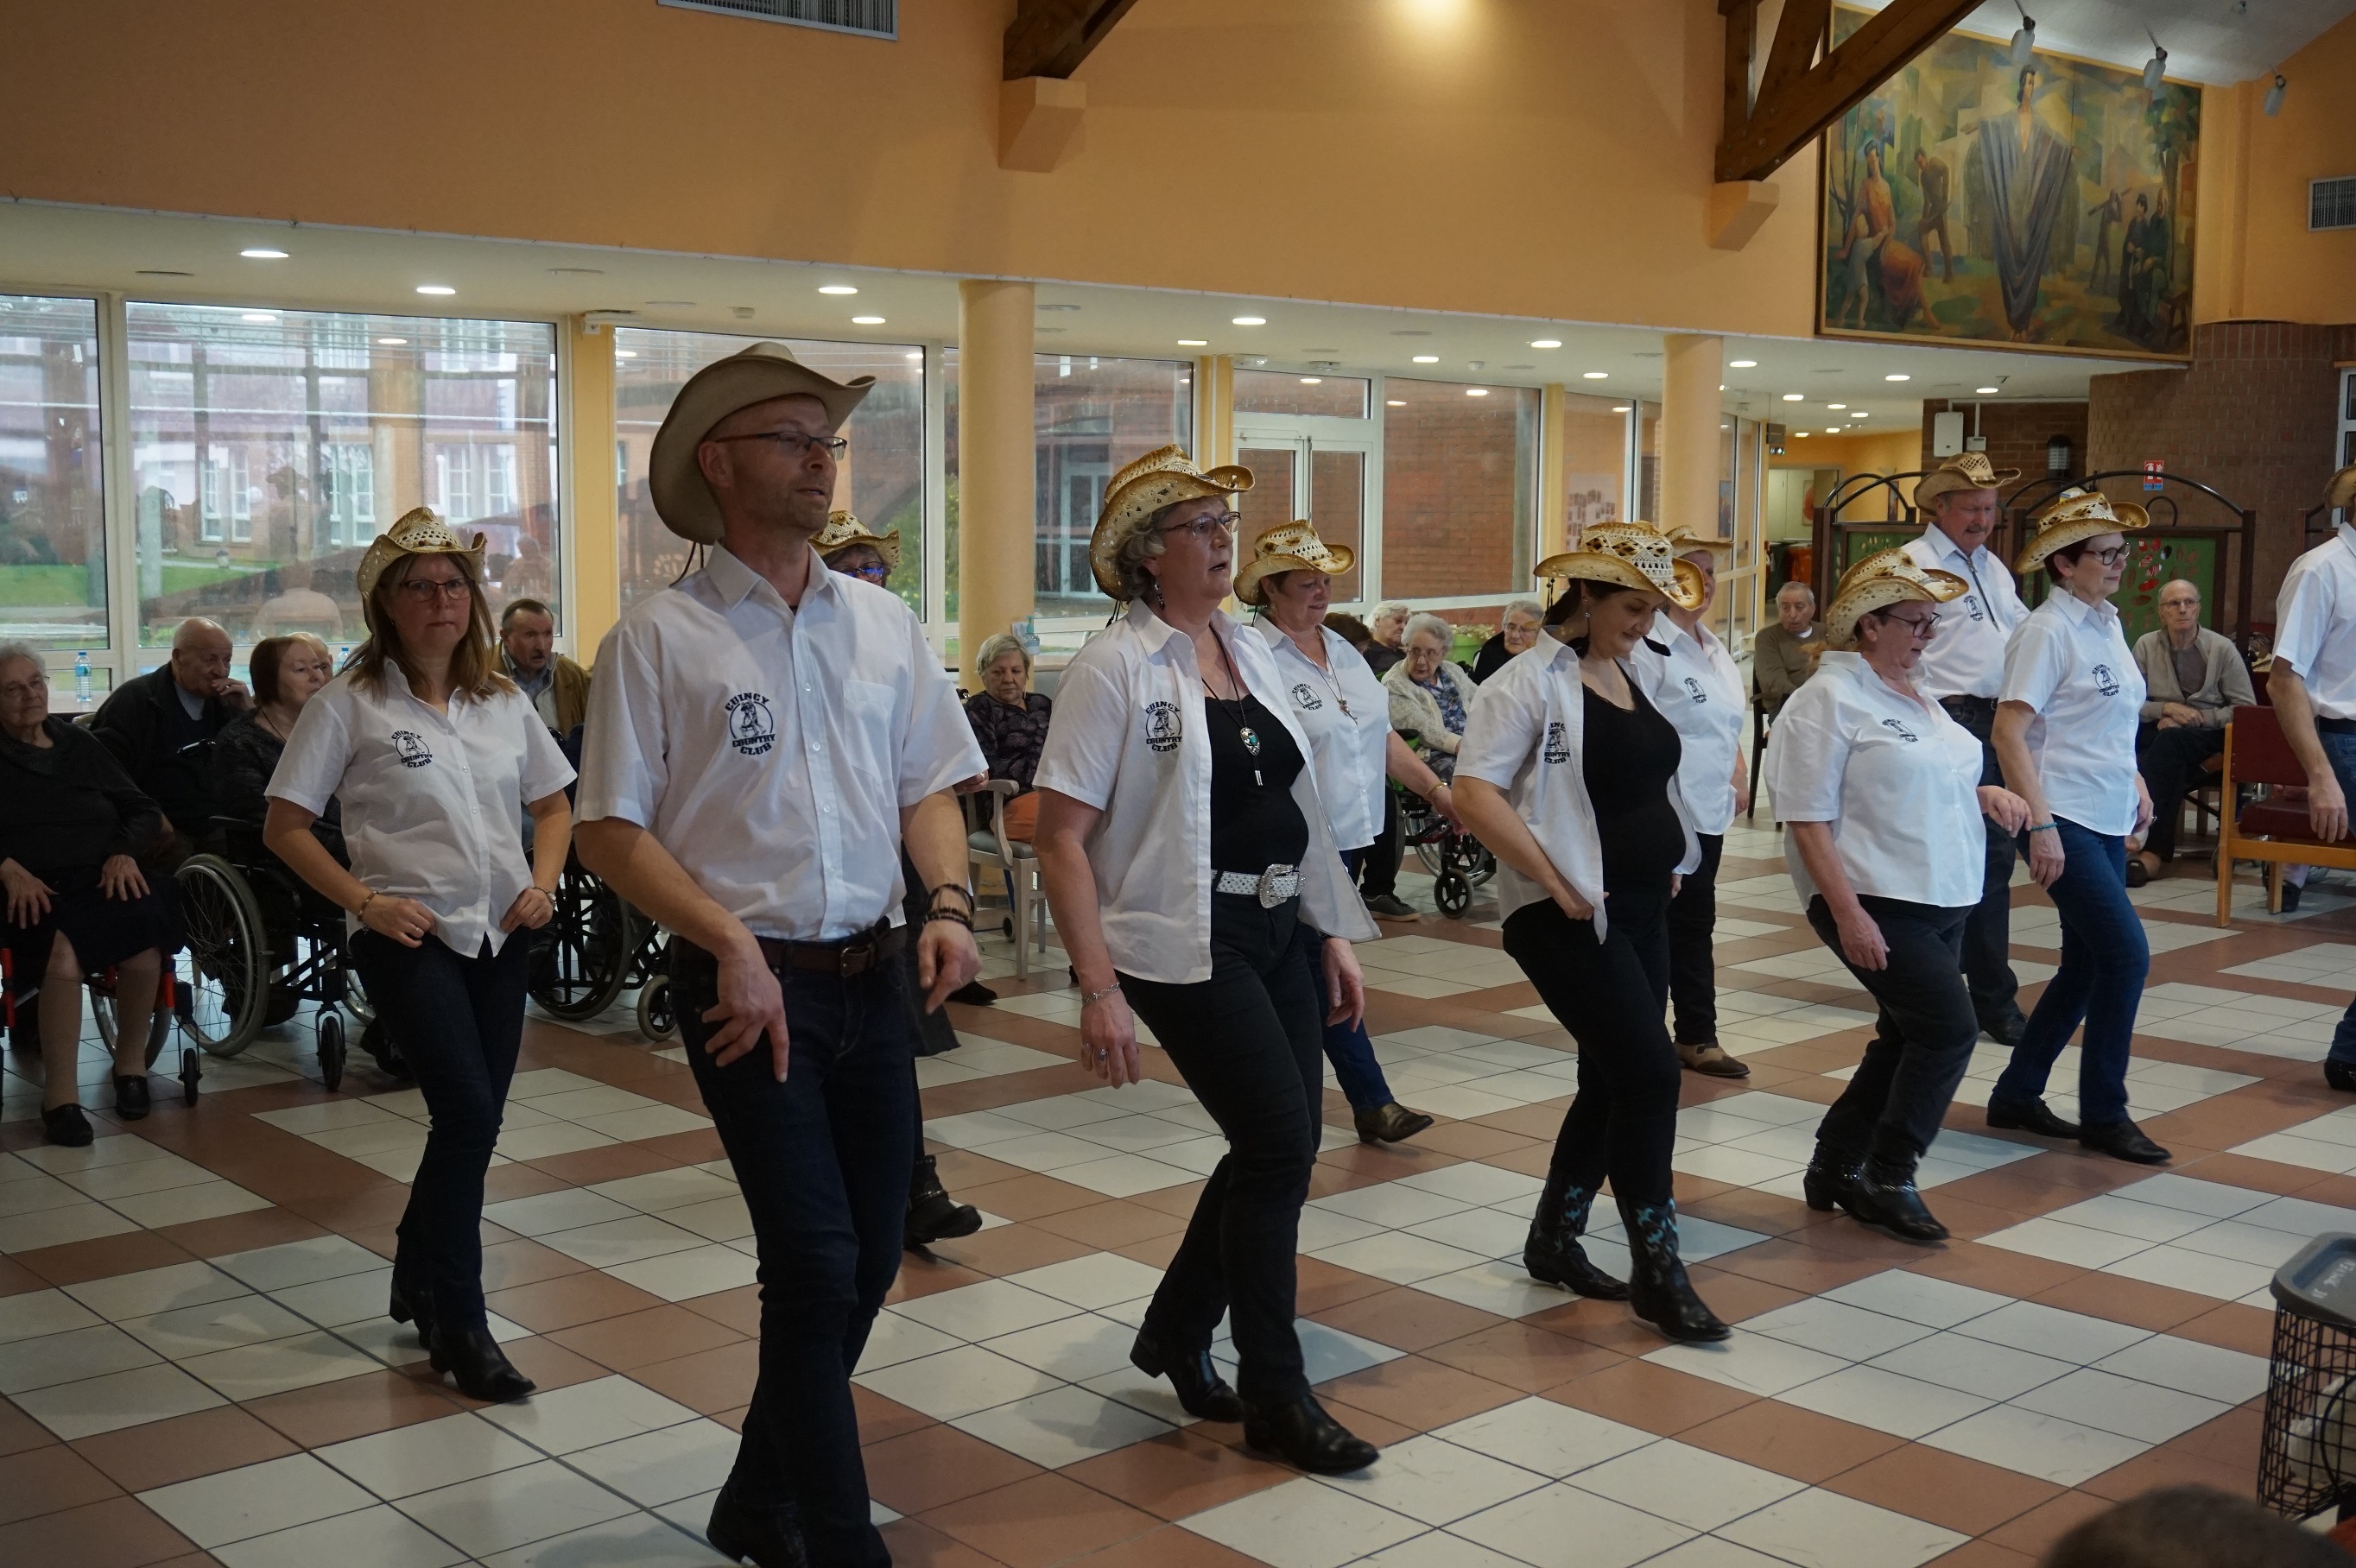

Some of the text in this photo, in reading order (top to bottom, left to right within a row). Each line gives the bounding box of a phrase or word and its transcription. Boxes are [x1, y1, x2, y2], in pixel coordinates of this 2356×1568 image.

[725, 692, 770, 711] CUINCY
[1145, 700, 1181, 715] CUINCY
[732, 733, 776, 748] COUNTRY
[1146, 736, 1182, 745] COUNTRY
[740, 743, 772, 756] CLUB
[1151, 743, 1178, 752] CLUB
[407, 758, 432, 768] CLUB
